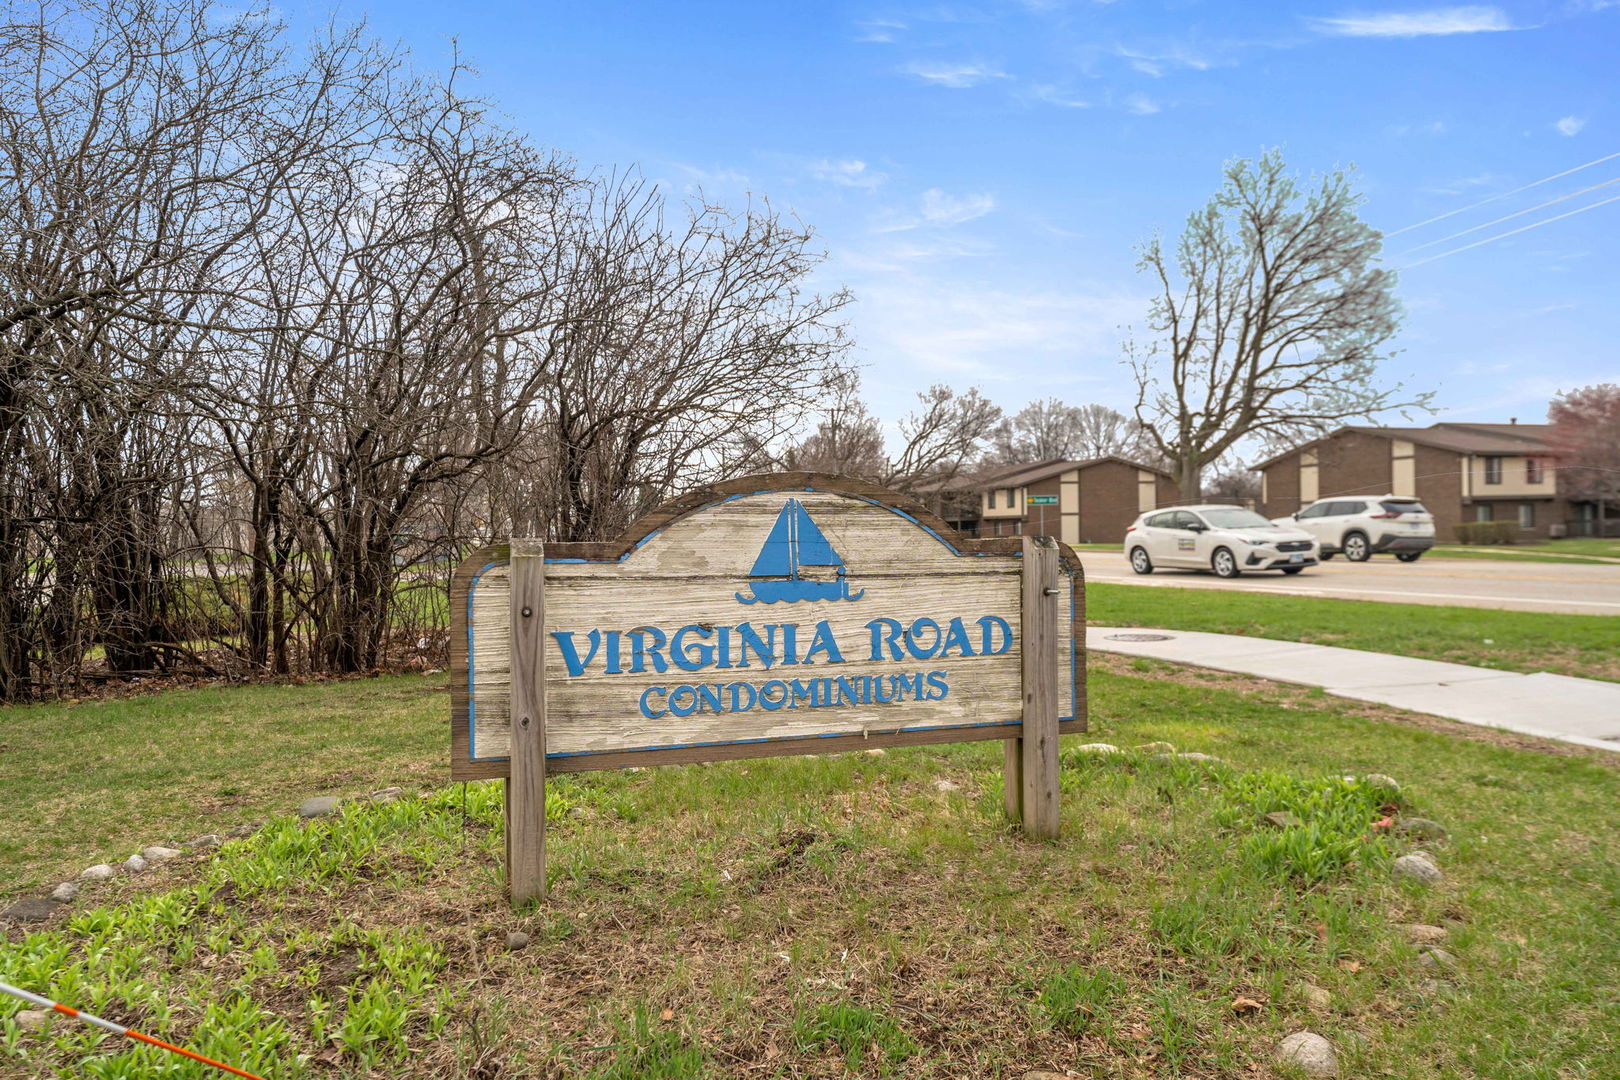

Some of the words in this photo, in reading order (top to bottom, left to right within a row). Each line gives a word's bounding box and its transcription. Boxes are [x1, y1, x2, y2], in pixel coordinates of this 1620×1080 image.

[551, 620, 846, 677] VIRGINIA
[865, 615, 1013, 662] ROAD
[639, 671, 950, 719] CONDOMINIUMS
